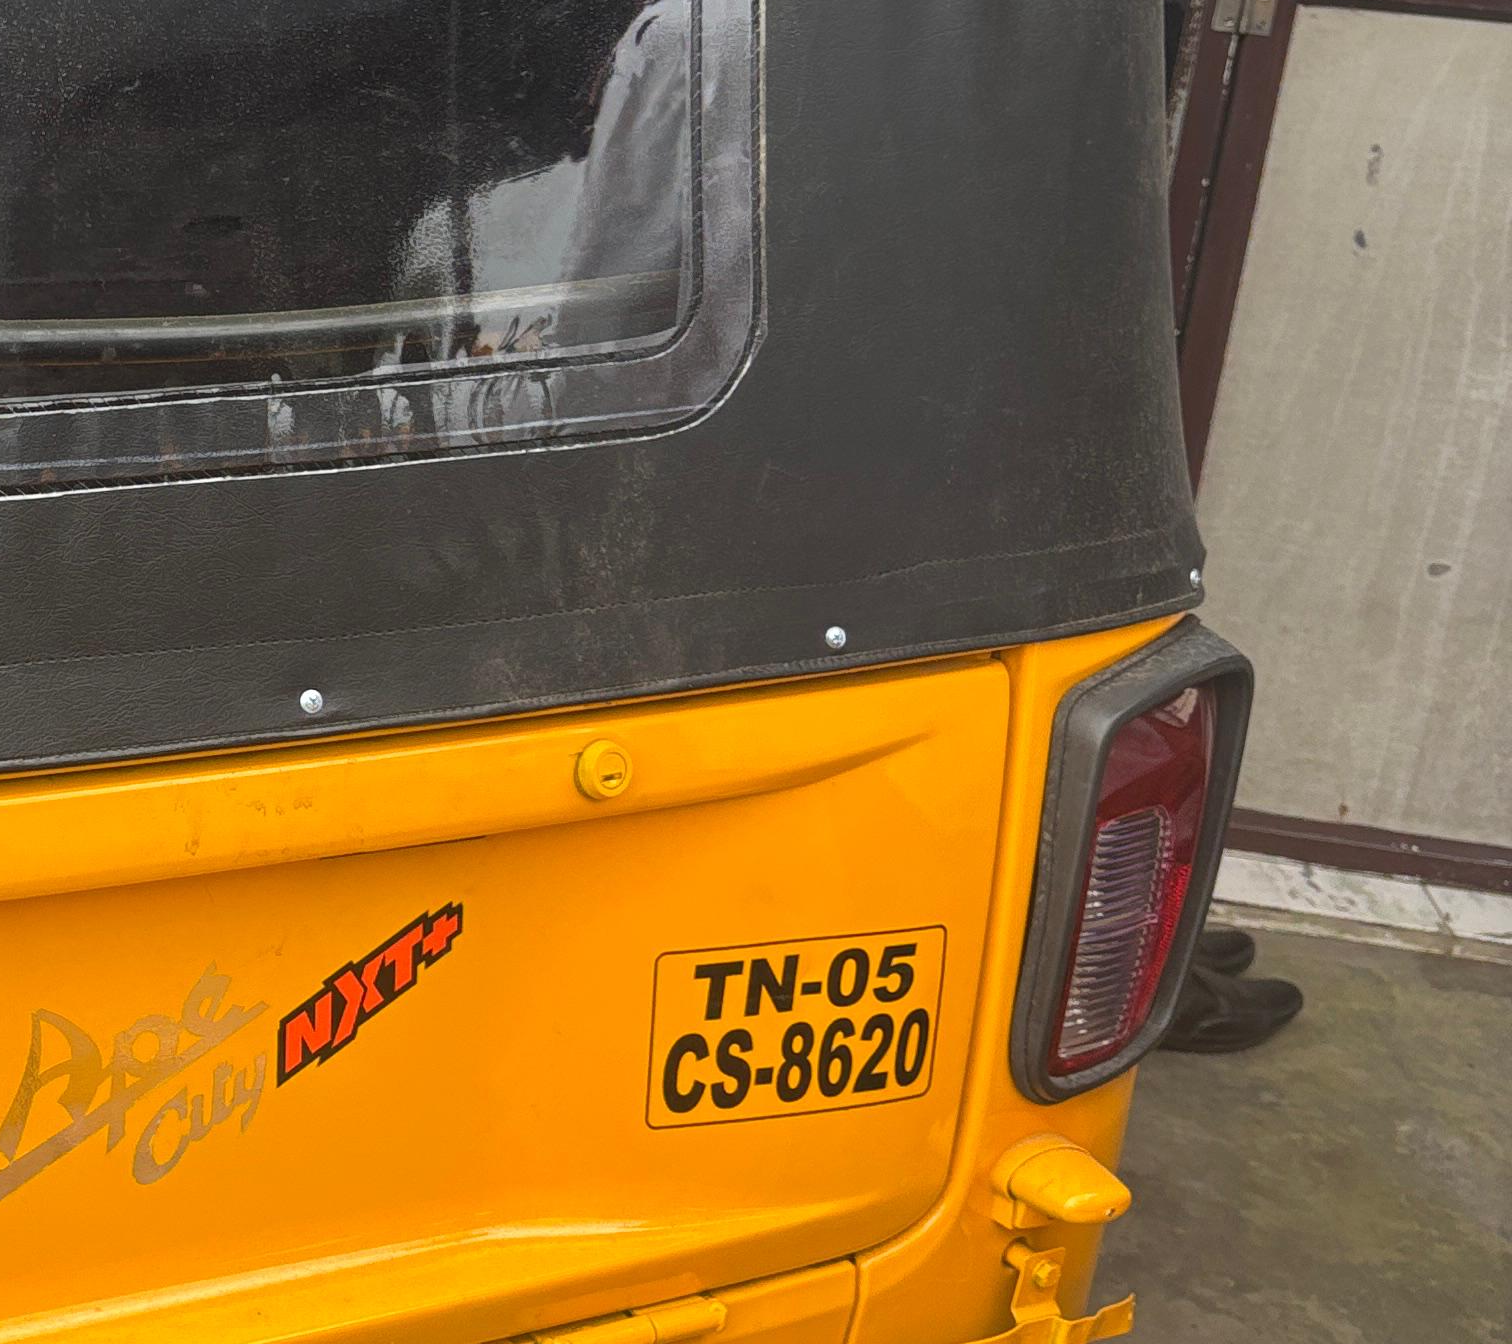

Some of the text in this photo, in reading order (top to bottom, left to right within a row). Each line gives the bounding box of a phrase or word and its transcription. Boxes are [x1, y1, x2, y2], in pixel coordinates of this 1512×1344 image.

[277, 902, 463, 1087] NXT+
[694, 943, 917, 1020] TN-05
[132, 1053, 267, 1186] City
[662, 1008, 929, 1113] CS-8620
